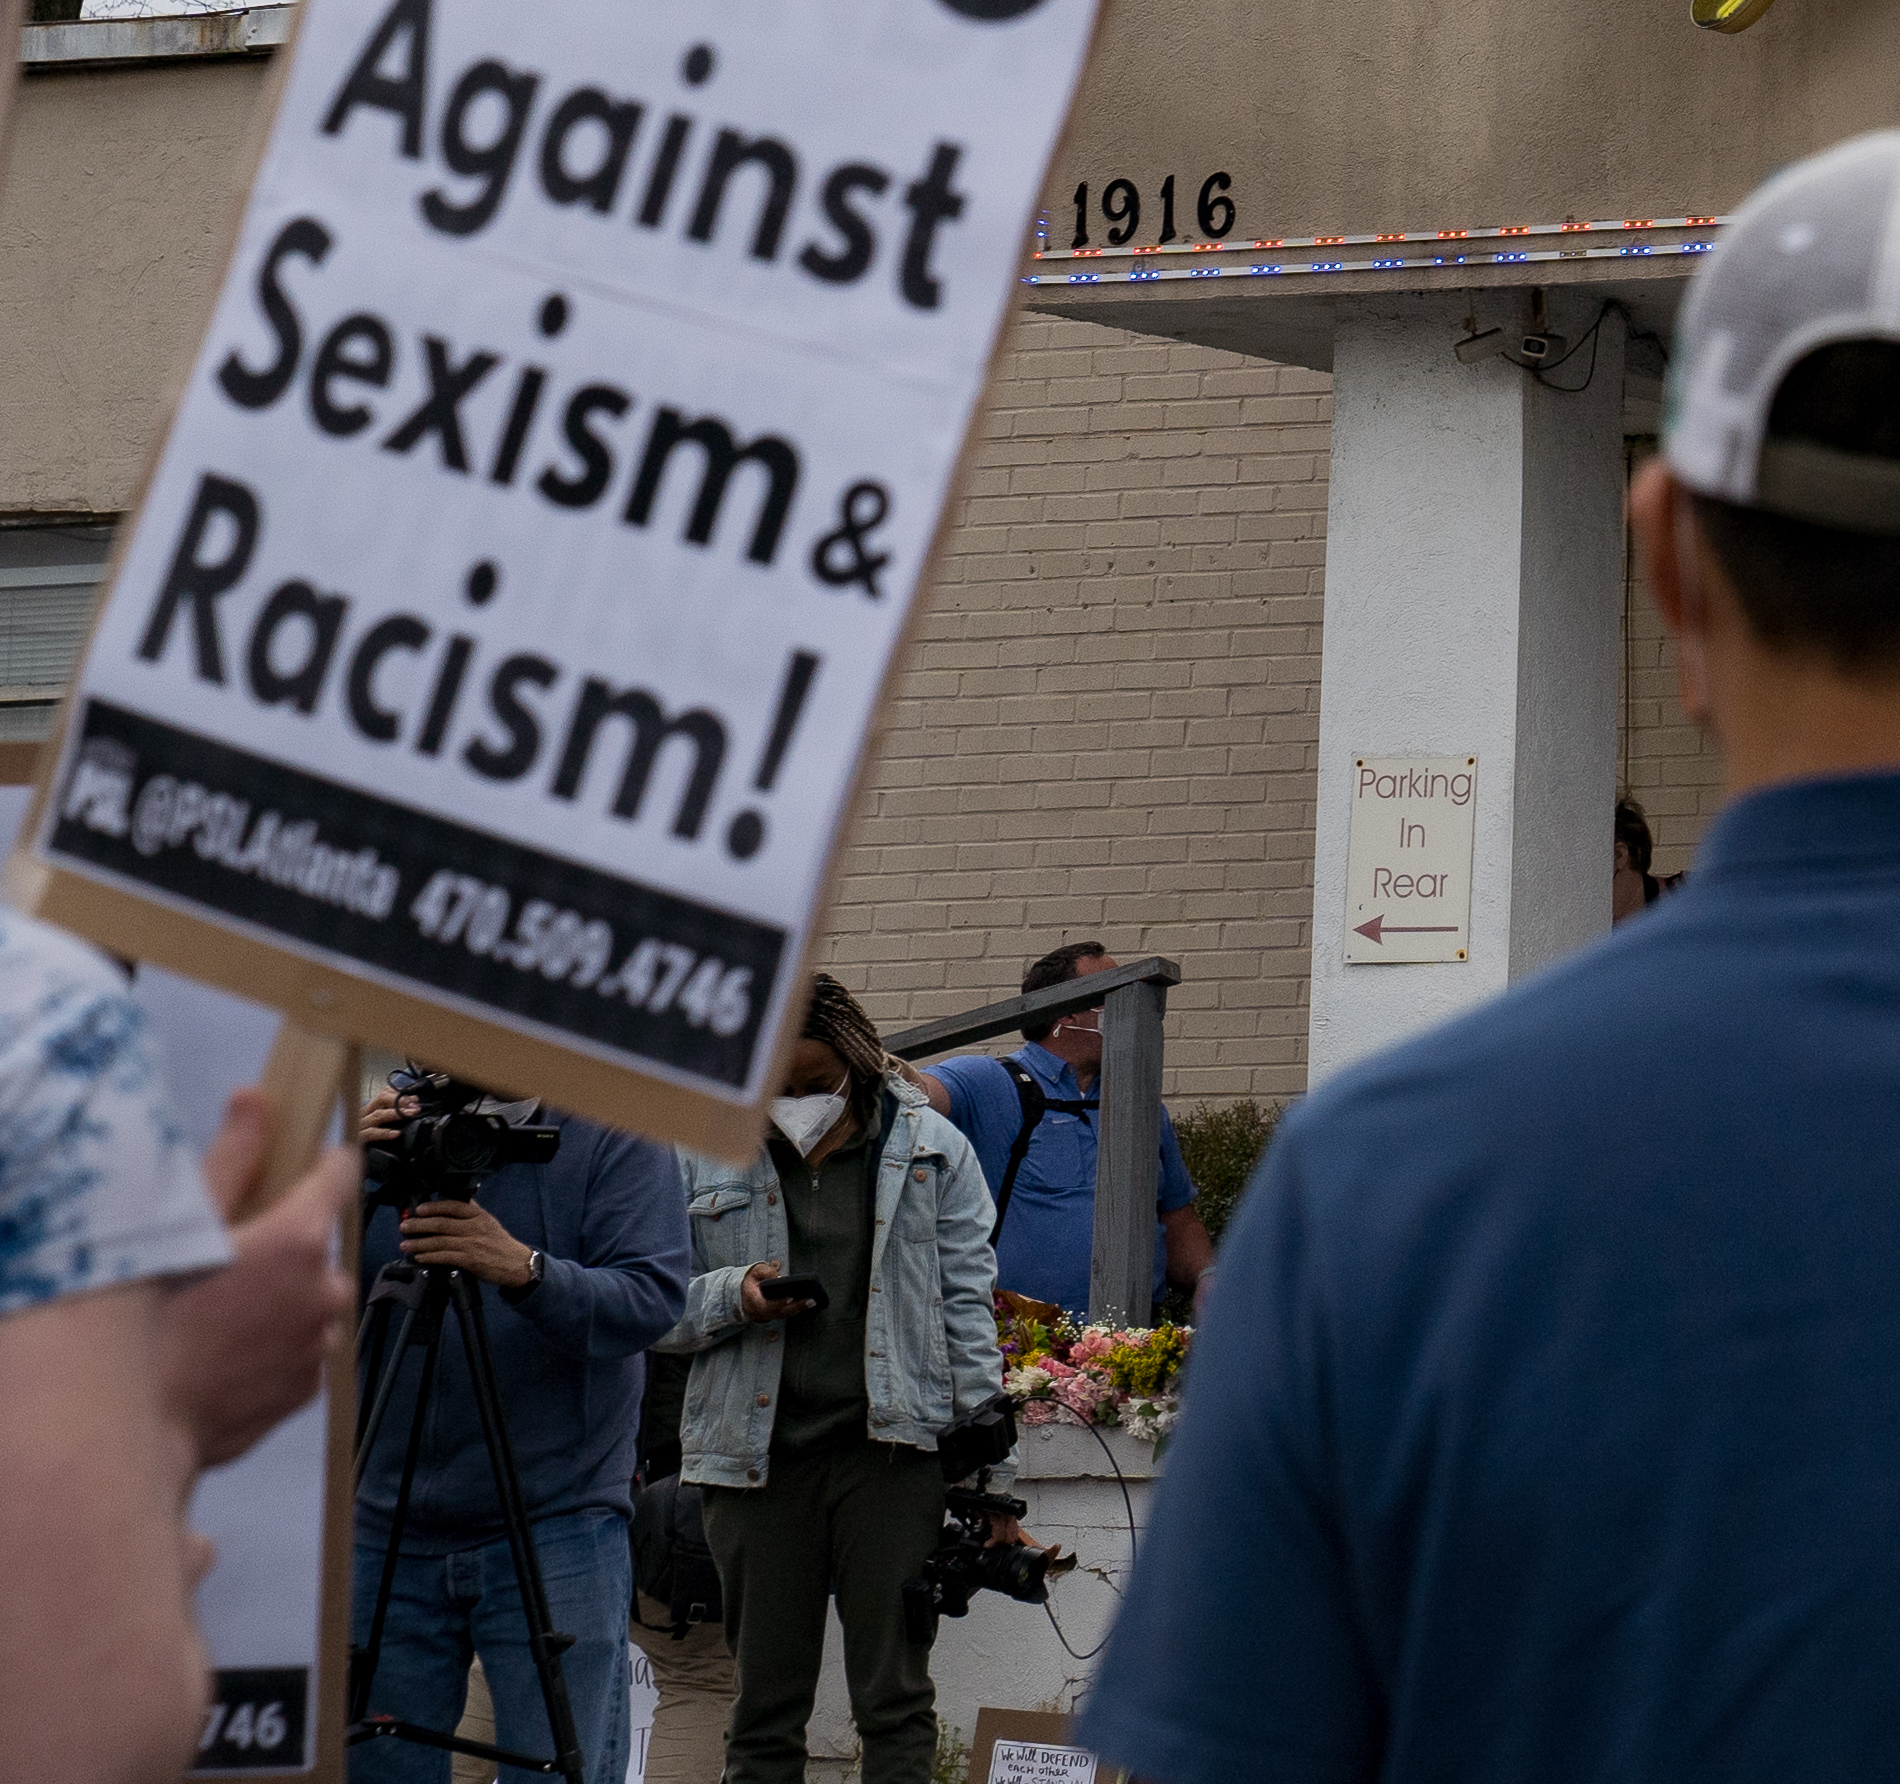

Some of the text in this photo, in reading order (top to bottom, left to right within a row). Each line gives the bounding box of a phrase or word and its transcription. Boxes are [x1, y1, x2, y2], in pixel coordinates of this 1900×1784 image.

[1071, 171, 1235, 249] 1916
[217, 218, 895, 600] Sexism &
[135, 473, 825, 862] Racism!
[1359, 768, 1471, 805] Parking
[1400, 818, 1425, 848] In
[131, 774, 401, 917] @PSLAtlanta
[410, 869, 753, 1038] 470.509.4746
[1373, 868, 1448, 898] Rear
[1001, 1748, 1014, 1761] We
